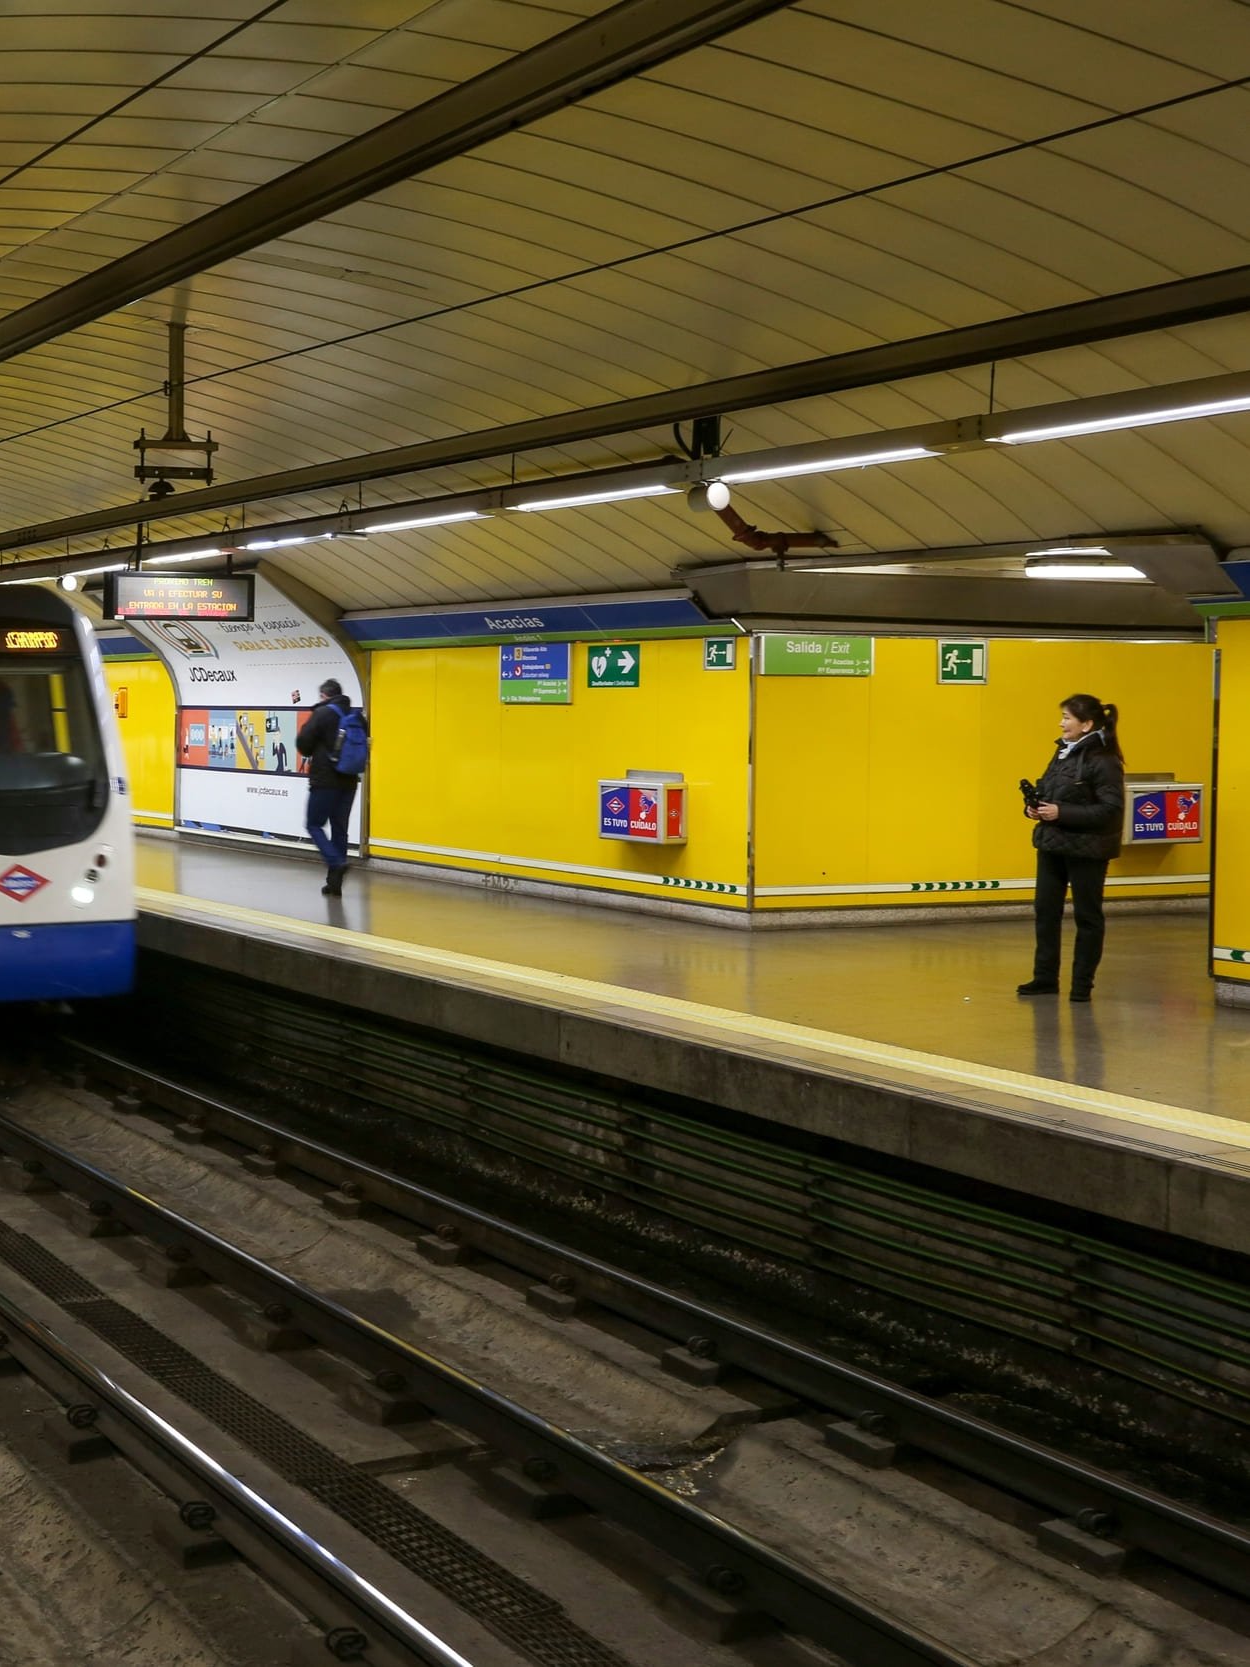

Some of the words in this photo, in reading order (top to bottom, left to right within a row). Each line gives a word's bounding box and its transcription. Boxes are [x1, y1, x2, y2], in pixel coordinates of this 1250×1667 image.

[194, 578, 213, 587] TREN
[158, 590, 165, 598] A
[168, 590, 208, 599] EFECTUAR
[211, 591, 223, 599] SU
[128, 601, 164, 610] ENTRADA
[168, 602, 179, 610] EN
[182, 602, 193, 610] LA
[197, 603, 237, 611] ESTACION
[219, 621, 254, 636] tiempo
[255, 622, 266, 635] y
[484, 615, 546, 630] Acacias
[234, 640, 261, 652] PARA
[260, 640, 276, 651] EL
[786, 640, 822, 653] Salida
[830, 641, 850, 654] Exit
[189, 667, 238, 683] JCDecaux
[246, 786, 289, 797] www.jcdecaux.es
[604, 817, 612, 826] ES
[612, 818, 628, 828] TUYO
[630, 819, 657, 831] CUÍDALO
[1135, 823, 1145, 832] ES
[1145, 822, 1165, 831] TUYO
[1167, 820, 1198, 831] CUÍDALO
